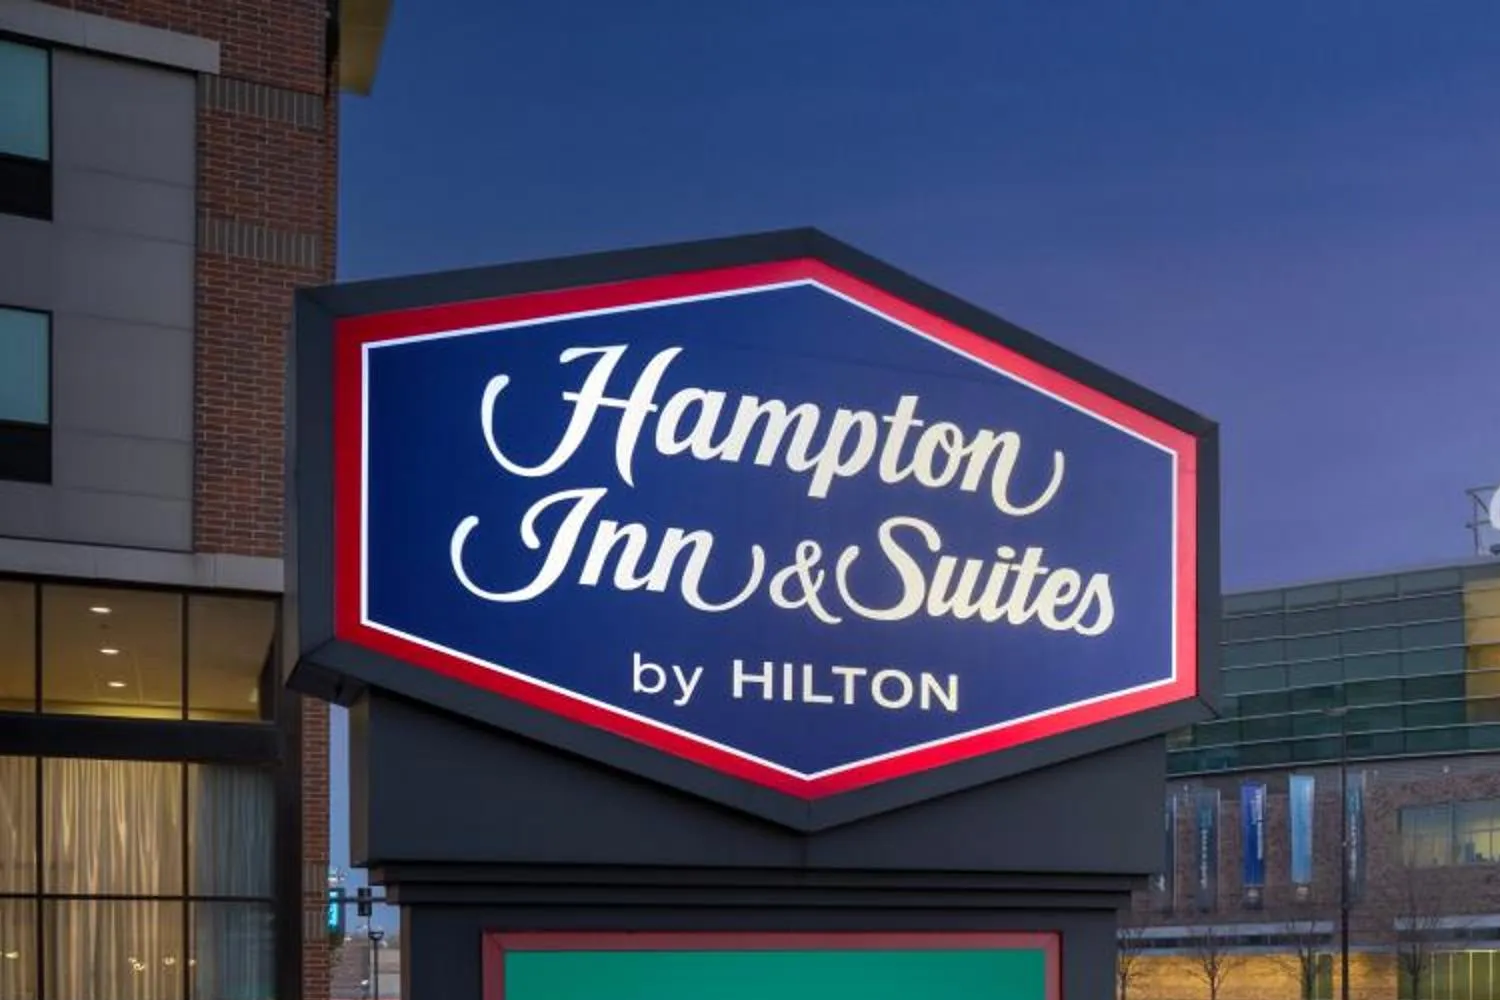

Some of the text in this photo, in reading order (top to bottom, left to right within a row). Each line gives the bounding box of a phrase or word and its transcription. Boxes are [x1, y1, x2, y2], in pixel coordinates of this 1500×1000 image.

[481, 344, 1065, 516] Hampton
[450, 487, 1115, 637] Inn & Suites
[632, 652, 959, 713] by HILTON
